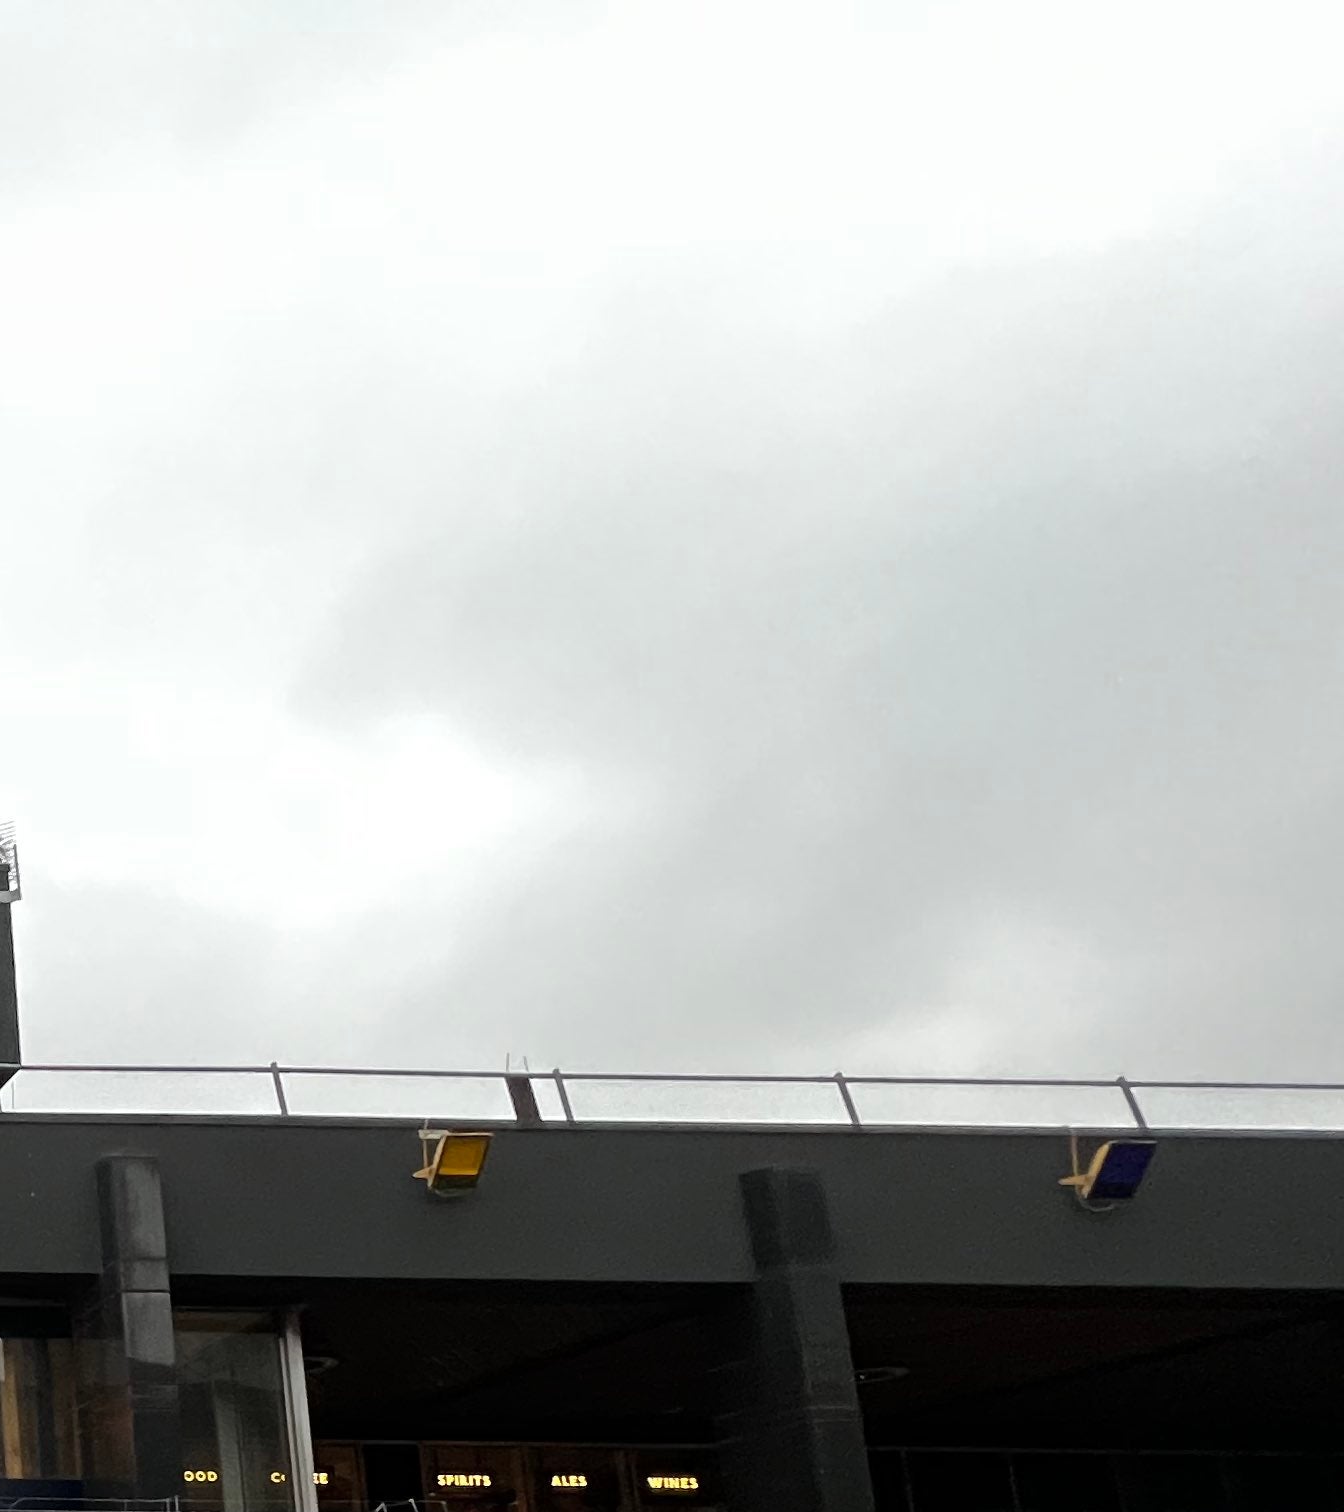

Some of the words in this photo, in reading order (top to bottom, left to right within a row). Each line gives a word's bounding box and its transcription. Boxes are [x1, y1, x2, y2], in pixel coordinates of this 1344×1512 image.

[183, 1470, 218, 1482] OOD
[437, 1474, 492, 1488] SPIRITS
[550, 1475, 588, 1488] ALES
[647, 1476, 699, 1490] WINES
